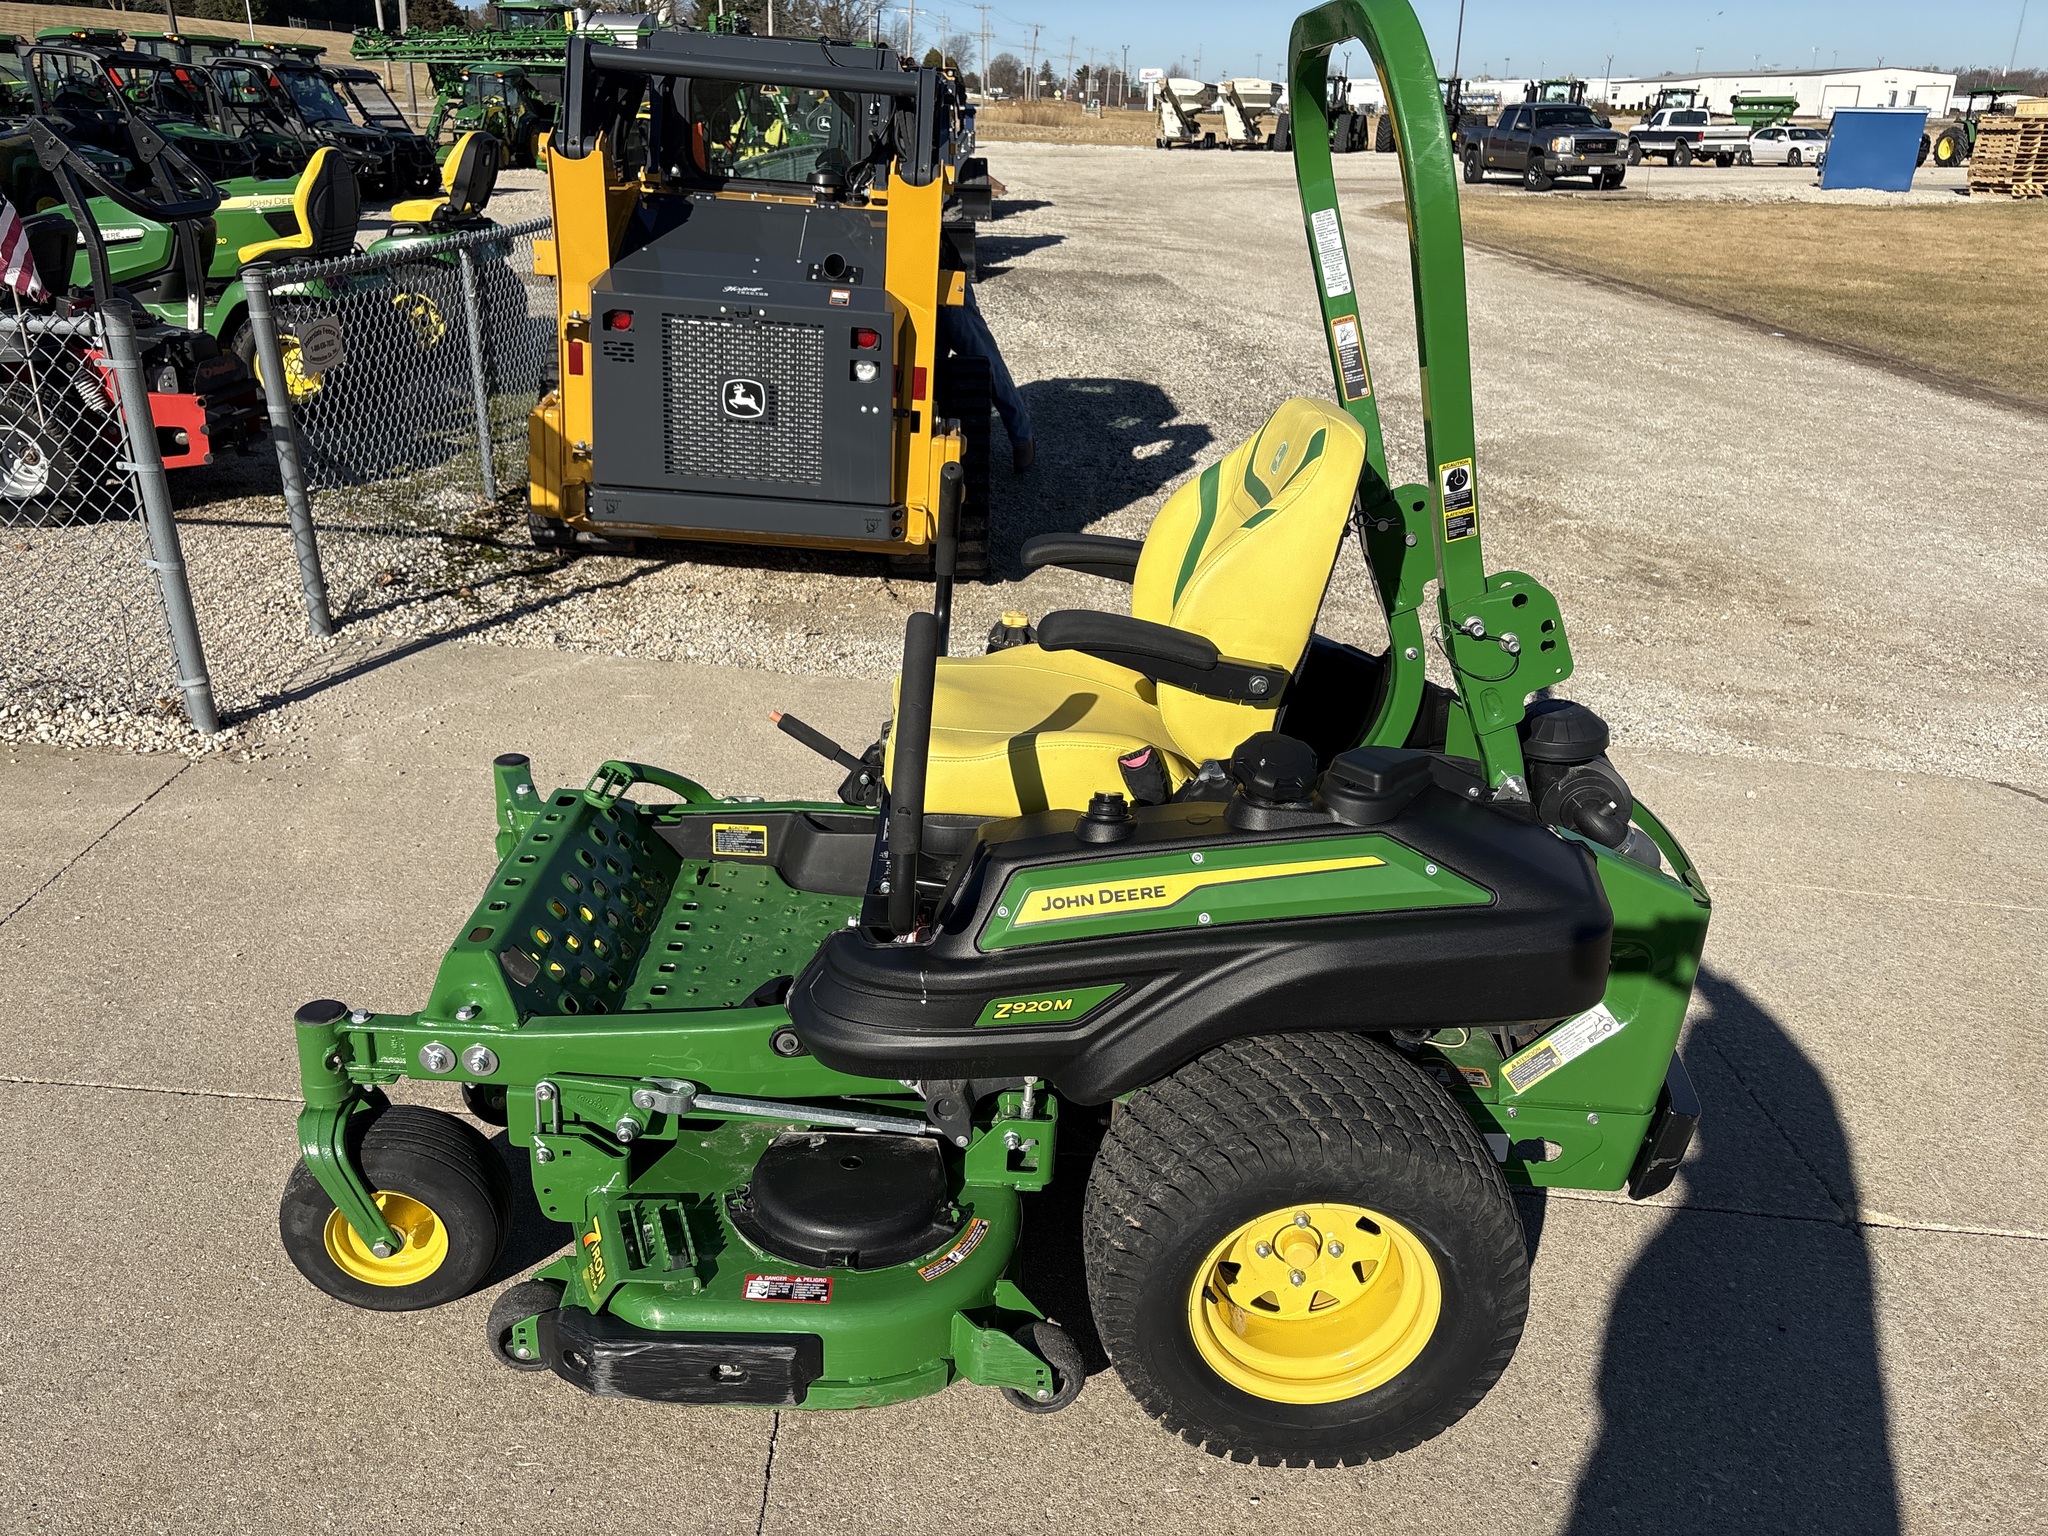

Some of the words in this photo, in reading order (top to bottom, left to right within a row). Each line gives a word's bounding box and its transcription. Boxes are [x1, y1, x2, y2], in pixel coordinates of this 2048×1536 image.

[247, 199, 273, 207] JOHN
[274, 197, 294, 205] DEE
[722, 285, 764, 293] Heritage
[1446, 459, 1469, 468] CAUTION
[1041, 893, 1095, 912] JOHN
[1098, 885, 1167, 905] DEERE
[993, 998, 1073, 1020] Z920M
[1515, 1046, 1542, 1066] ATENCIÓN
